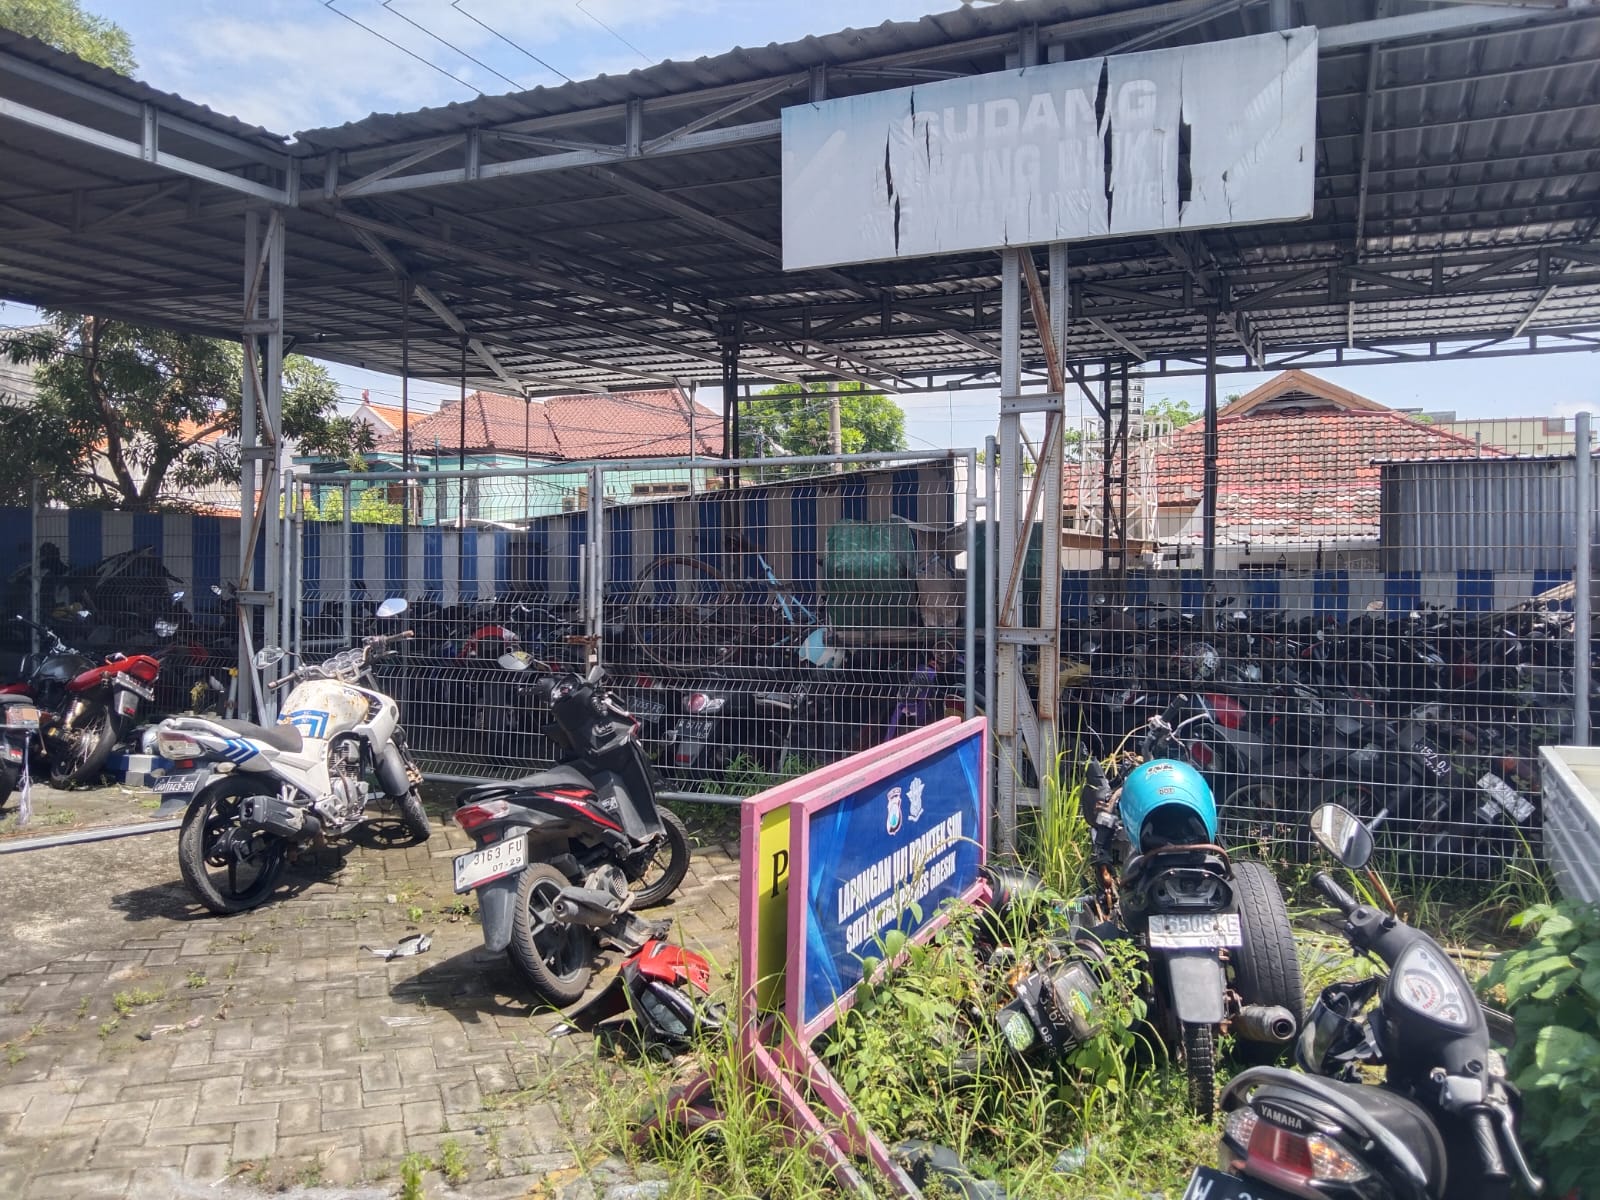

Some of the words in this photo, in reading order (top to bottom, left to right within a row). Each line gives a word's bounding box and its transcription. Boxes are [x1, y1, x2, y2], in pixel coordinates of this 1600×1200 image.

[474, 848, 501, 866] 3163
[508, 839, 522, 855] FU
[930, 850, 956, 891] GRESIK
[838, 856, 892, 925] LAPANGAN
[1261, 1104, 1302, 1129] YAMAHA
